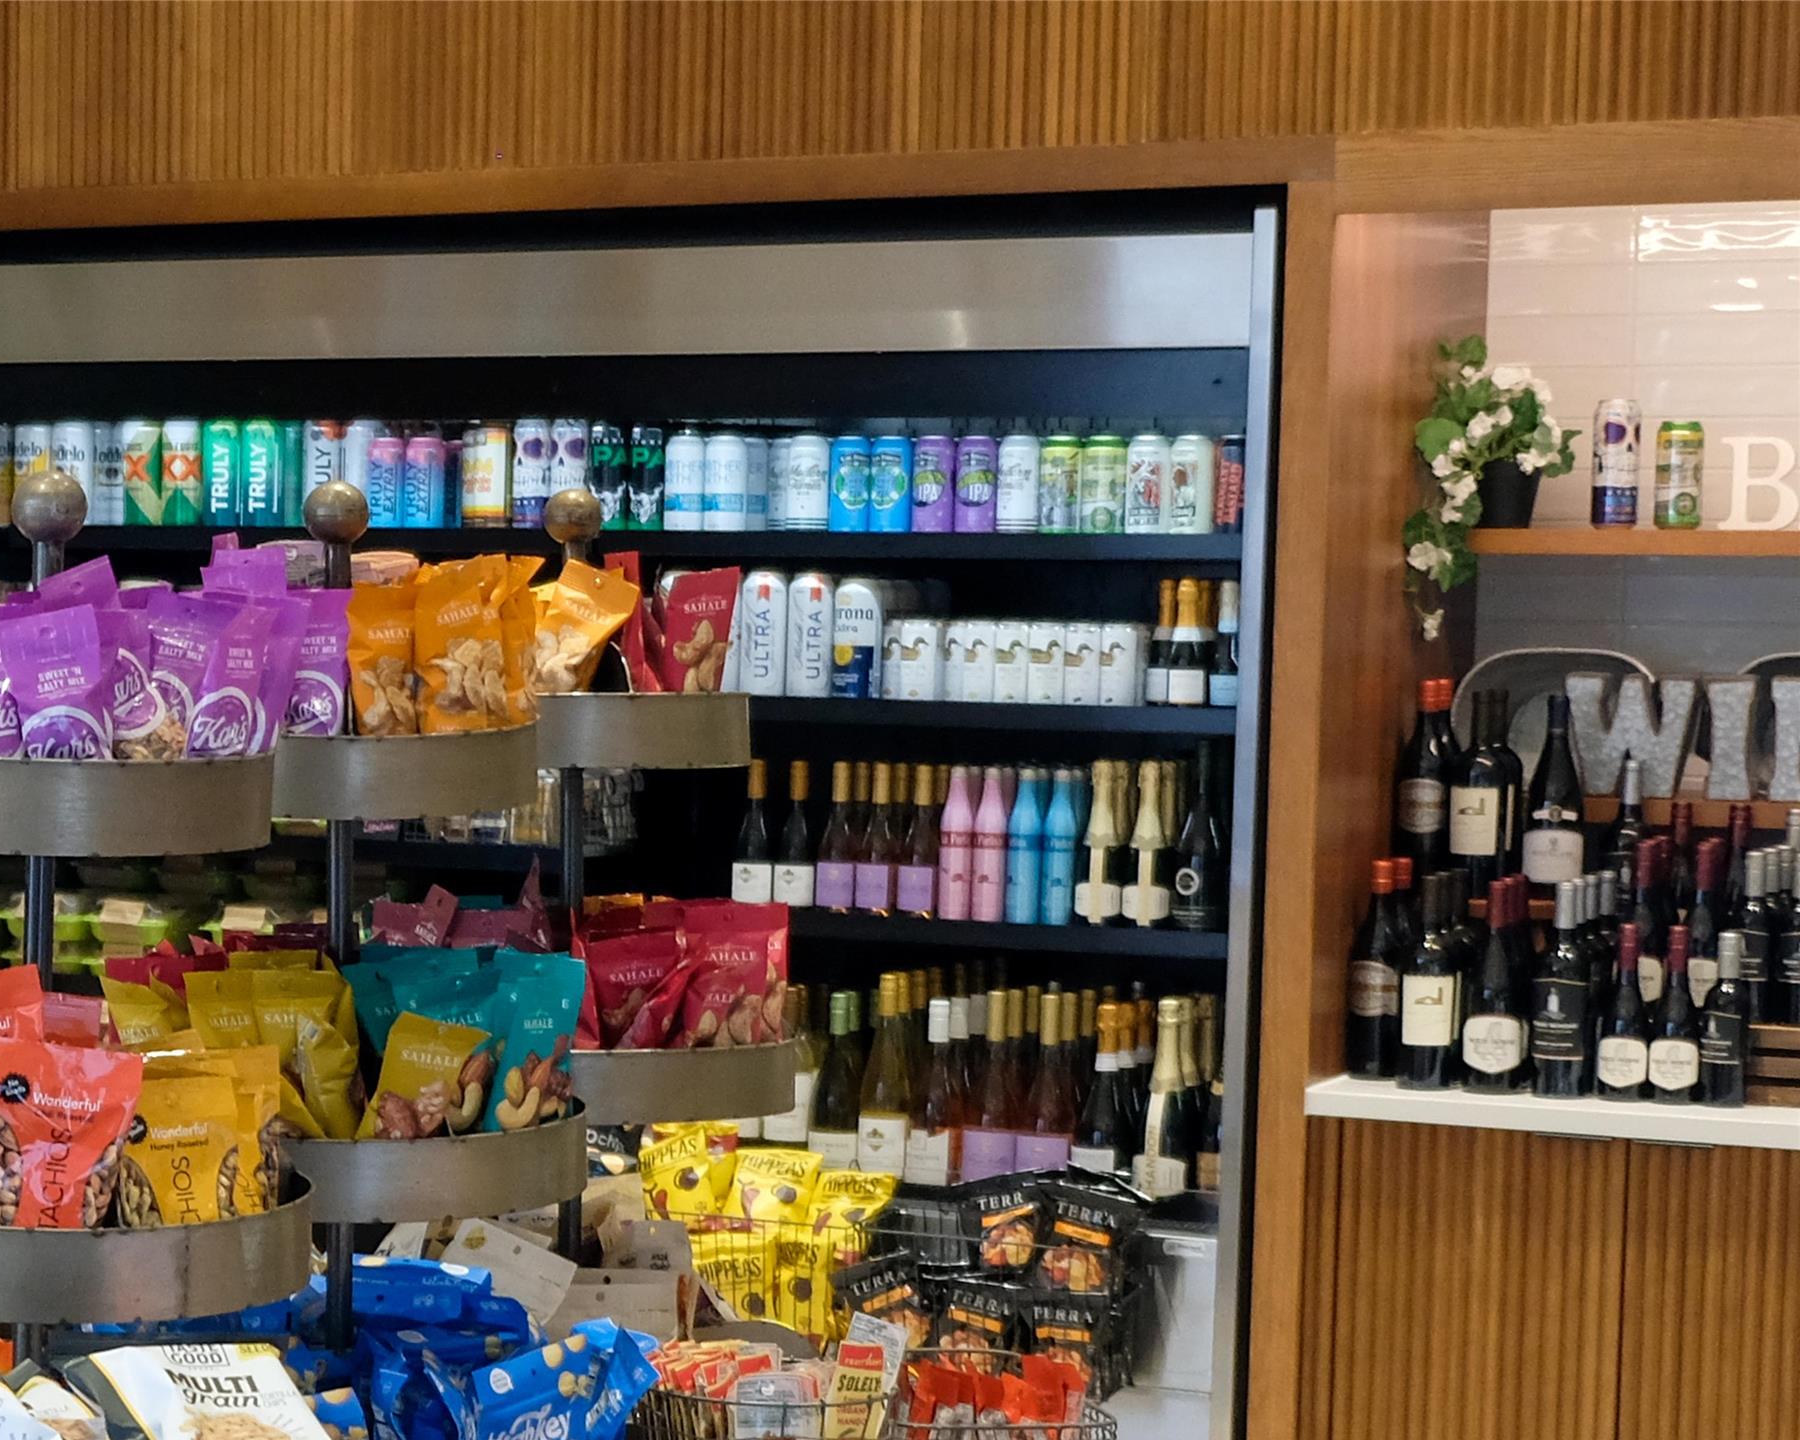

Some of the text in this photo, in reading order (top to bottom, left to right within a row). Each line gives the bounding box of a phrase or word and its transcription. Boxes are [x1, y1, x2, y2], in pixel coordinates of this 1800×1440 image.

[210, 444, 230, 513] TRULY
[248, 444, 267, 513] TRULY
[314, 448, 332, 486] ULY
[836, 607, 874, 621] rona
[367, 627, 412, 640] SAHAL
[754, 608, 771, 678] ULTRA
[806, 610, 823, 680] ULTRA
[194, 714, 249, 751] Kar's
[33, 1090, 102, 1113] Wonderful
[150, 1122, 209, 1140] Wonderful
[150, 1138, 209, 1153] Honey Roasted
[638, 1137, 697, 1171] HIPPEAS
[37, 1127, 73, 1228] TACHIOS
[977, 1191, 1024, 1212] TERR
[1055, 1201, 1116, 1228] TERRA
[851, 1270, 907, 1296] TERRA
[951, 1288, 1009, 1317] TERRA
[1033, 1304, 1095, 1325] TERRA
[170, 1352, 223, 1365] GOOD
[163, 1367, 259, 1394] MULTI
[837, 1373, 882, 1394] SOLELY
[182, 1388, 262, 1408] grain
